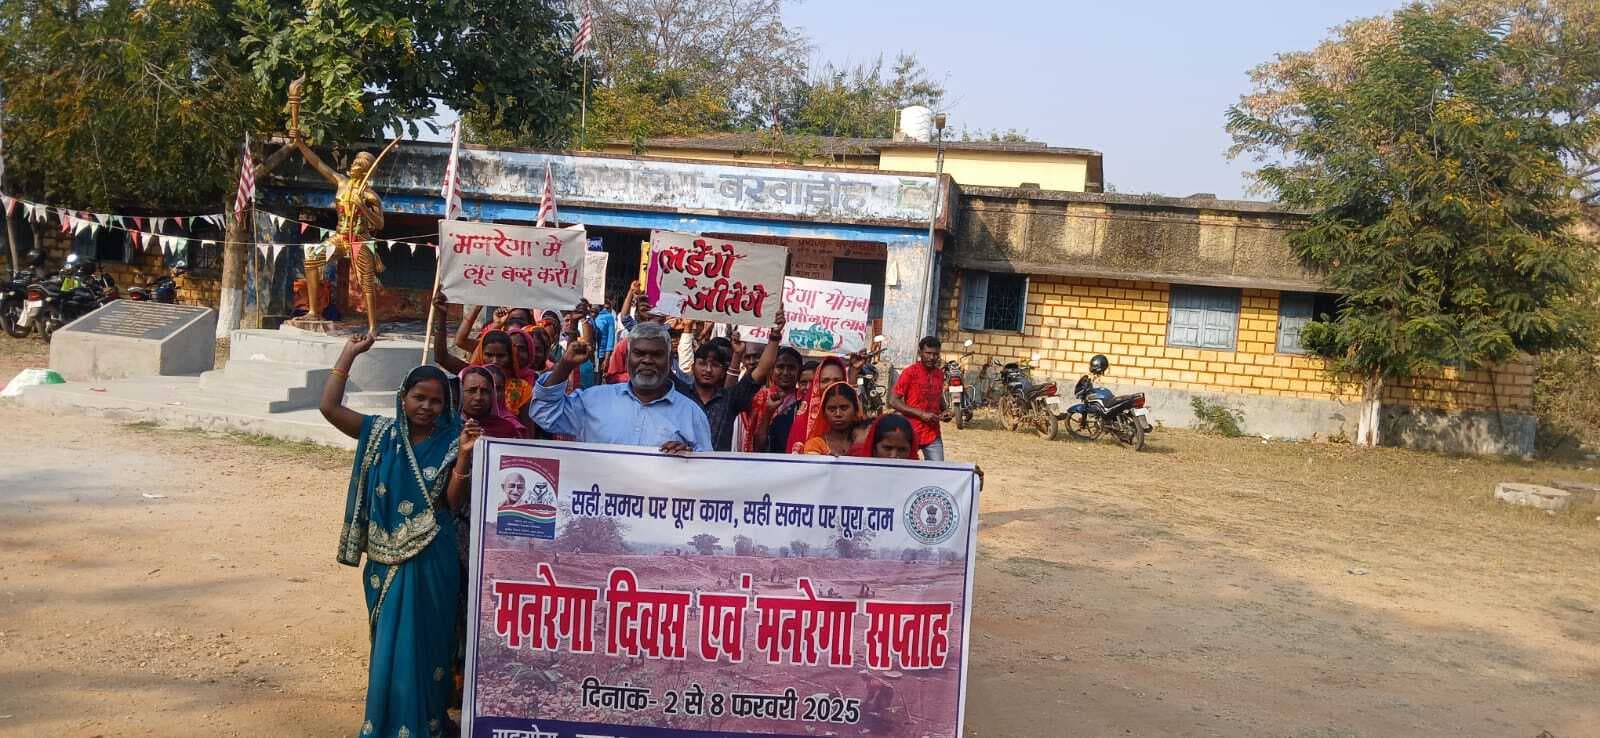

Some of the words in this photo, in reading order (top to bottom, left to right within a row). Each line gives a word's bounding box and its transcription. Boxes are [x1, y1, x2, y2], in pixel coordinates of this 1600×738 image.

[571, 483, 601, 516] सही
[604, 493, 645, 518] समय
[648, 496, 668, 519] पर
[672, 497, 697, 530] पूरा
[699, 499, 738, 528] काम,
[743, 493, 772, 527] सही
[775, 502, 815, 528] समय
[818, 504, 838, 529] पर
[841, 505, 864, 538] पूरा
[866, 507, 895, 532] दाम
[494, 564, 600, 653] मनरेगा
[606, 569, 692, 658] दिवस
[699, 575, 751, 661] एवं
[756, 578, 858, 666] मनरेगा
[865, 601, 952, 668] सप्ताह
[581, 678, 657, 711] दिनांक-
[664, 691, 678, 714] 2
[684, 684, 704, 715] से
[710, 693, 724, 716] 8
[731, 688, 798, 719] फरवरी
[802, 697, 860, 723] 2025
